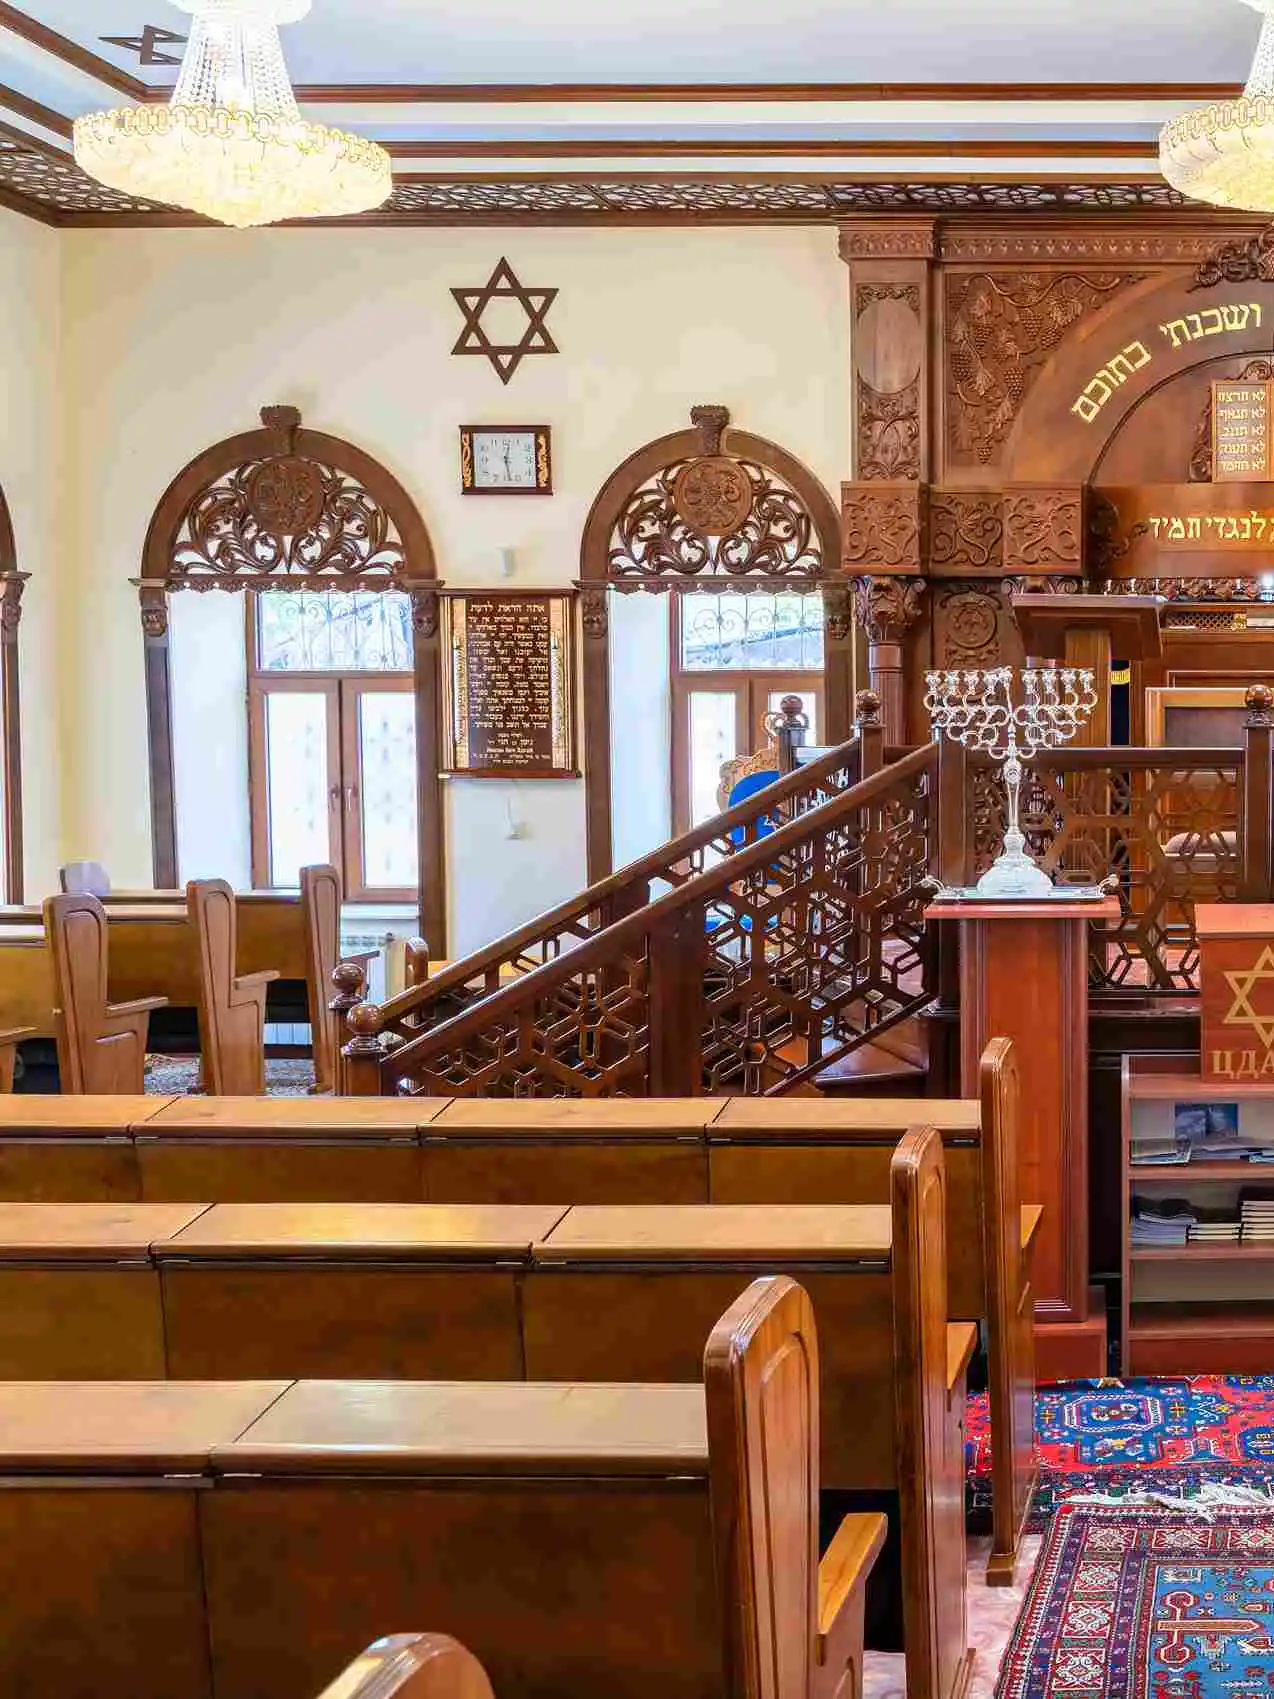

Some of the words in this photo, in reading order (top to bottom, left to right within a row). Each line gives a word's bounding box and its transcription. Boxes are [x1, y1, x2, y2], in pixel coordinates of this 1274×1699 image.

[1159, 303, 1262, 349] ושכנתי
[1071, 340, 1153, 424] בתוכם
[1149, 516, 1201, 540] תמיד
[1207, 510, 1267, 541] לנגדי
